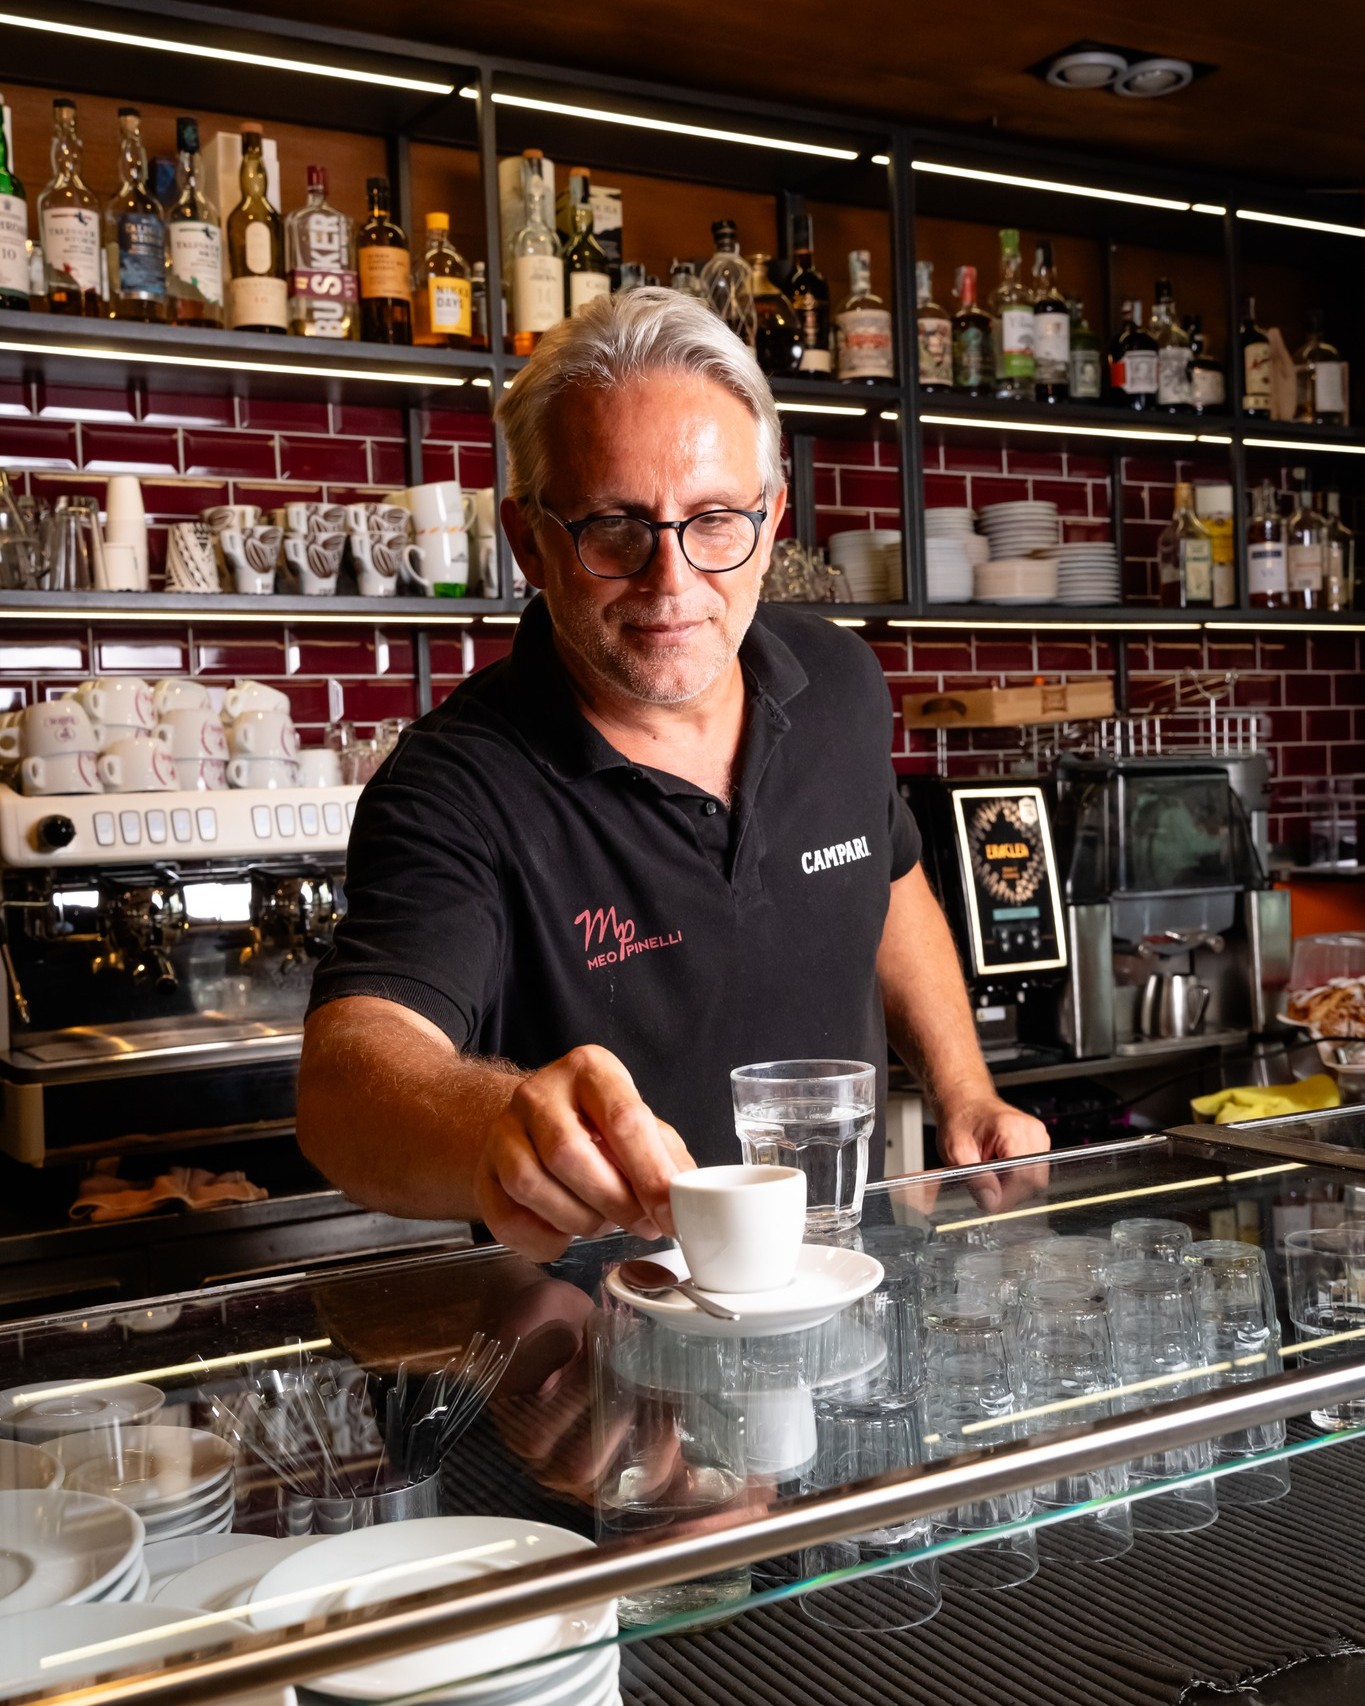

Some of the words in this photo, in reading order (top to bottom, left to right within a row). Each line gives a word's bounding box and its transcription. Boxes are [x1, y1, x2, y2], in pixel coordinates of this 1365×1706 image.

[2, 247, 17, 260] 10
[308, 213, 344, 339] BUSKER
[586, 950, 618, 972] MEO
[625, 929, 683, 958] PINELLI
